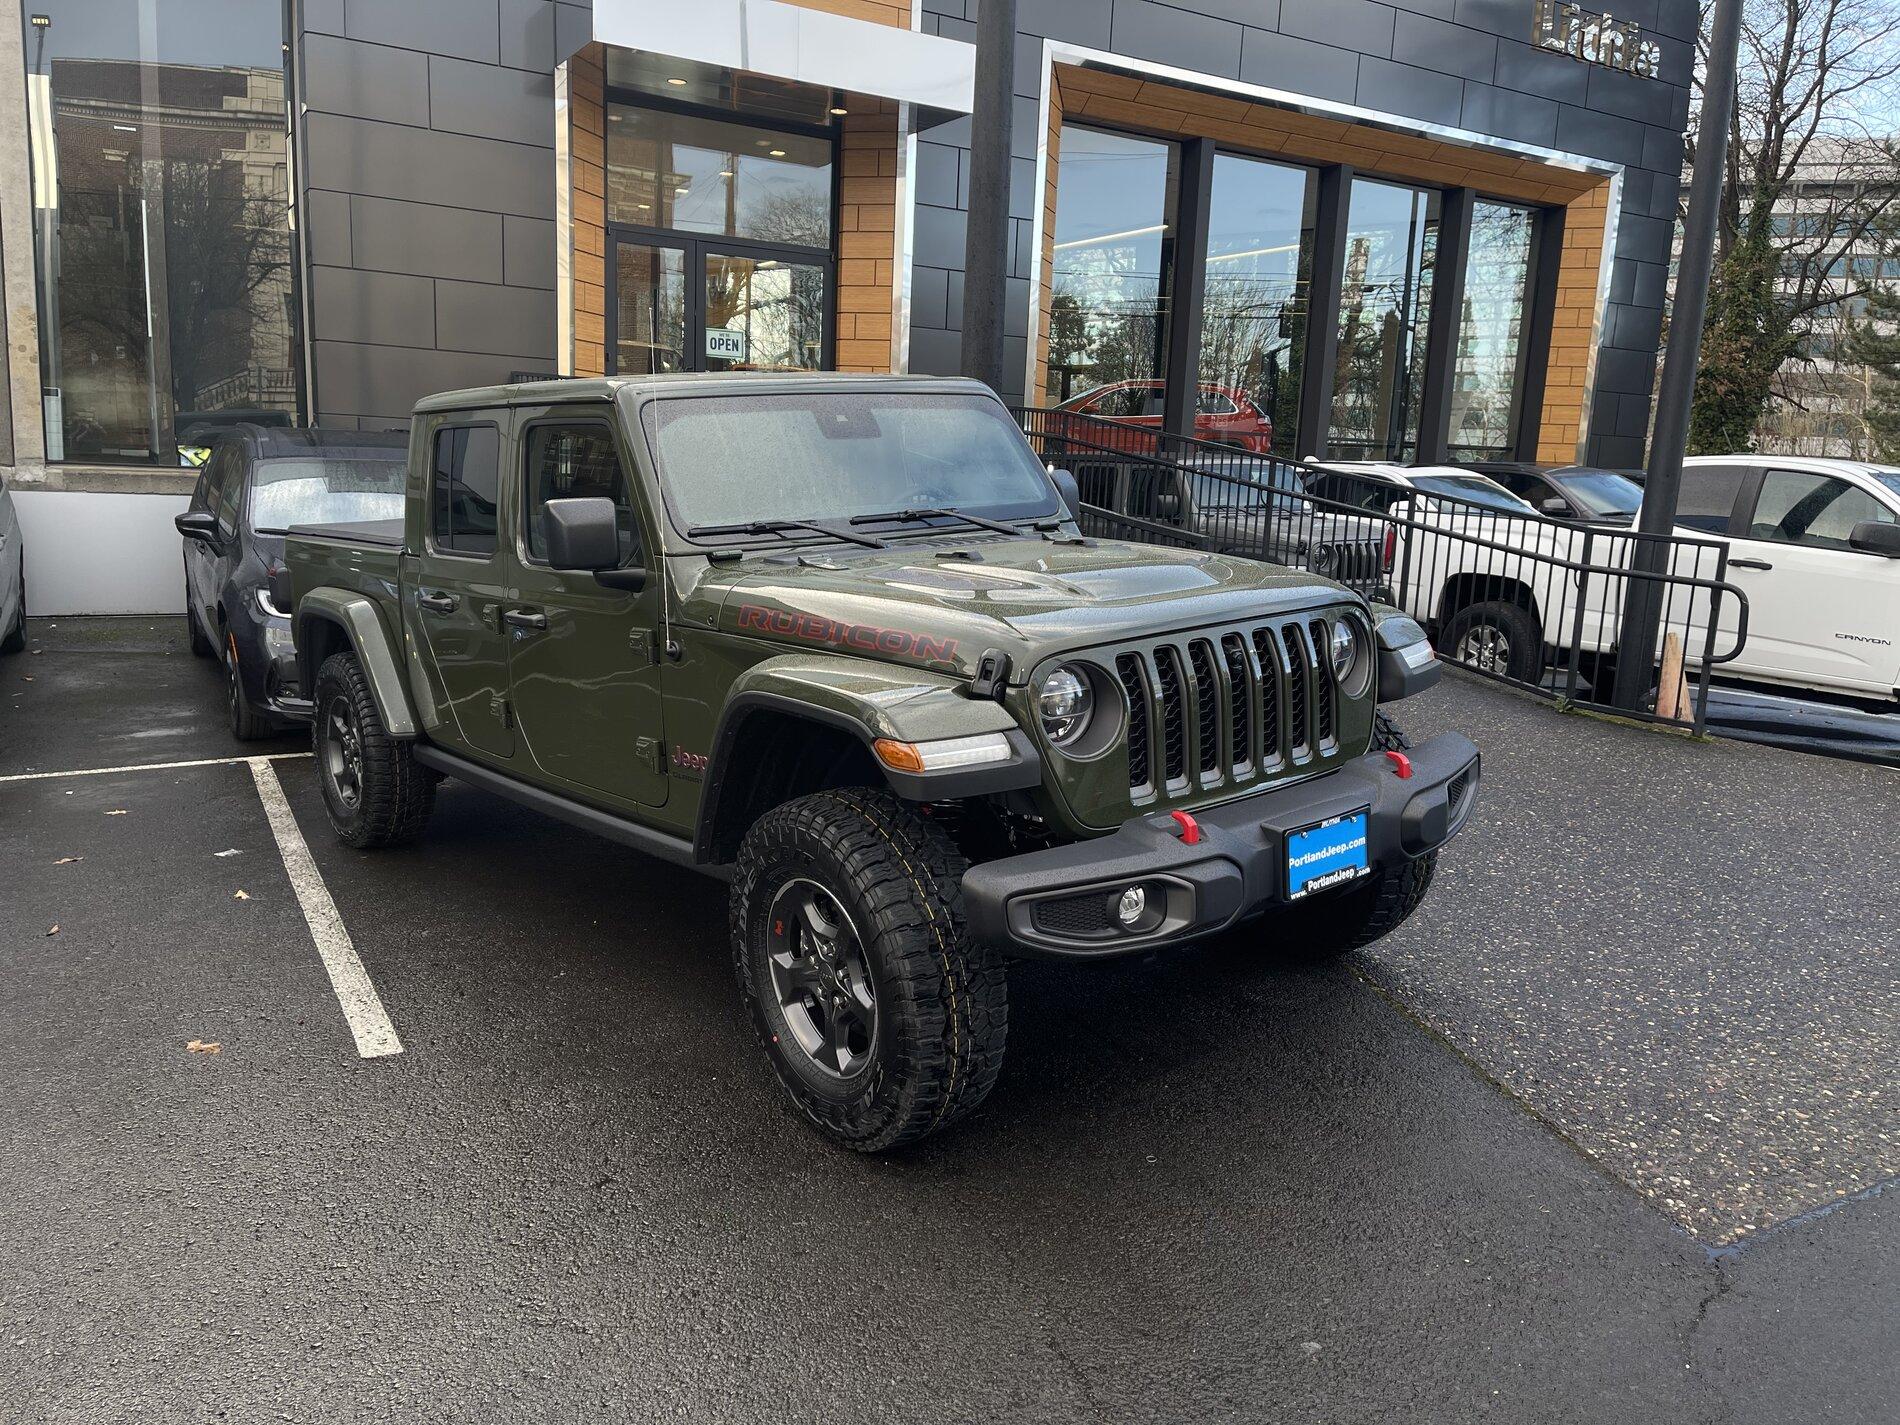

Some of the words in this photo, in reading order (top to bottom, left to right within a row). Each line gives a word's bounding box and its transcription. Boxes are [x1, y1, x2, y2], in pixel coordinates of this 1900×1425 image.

[710, 337, 739, 352] OPEN
[738, 604, 958, 662] RUBICON
[1835, 633, 1891, 646] CANYON
[1288, 836, 1366, 869] PortlandJeep.com
[1307, 867, 1355, 892] PortlandJeep
[1356, 866, 1371, 877] .com
